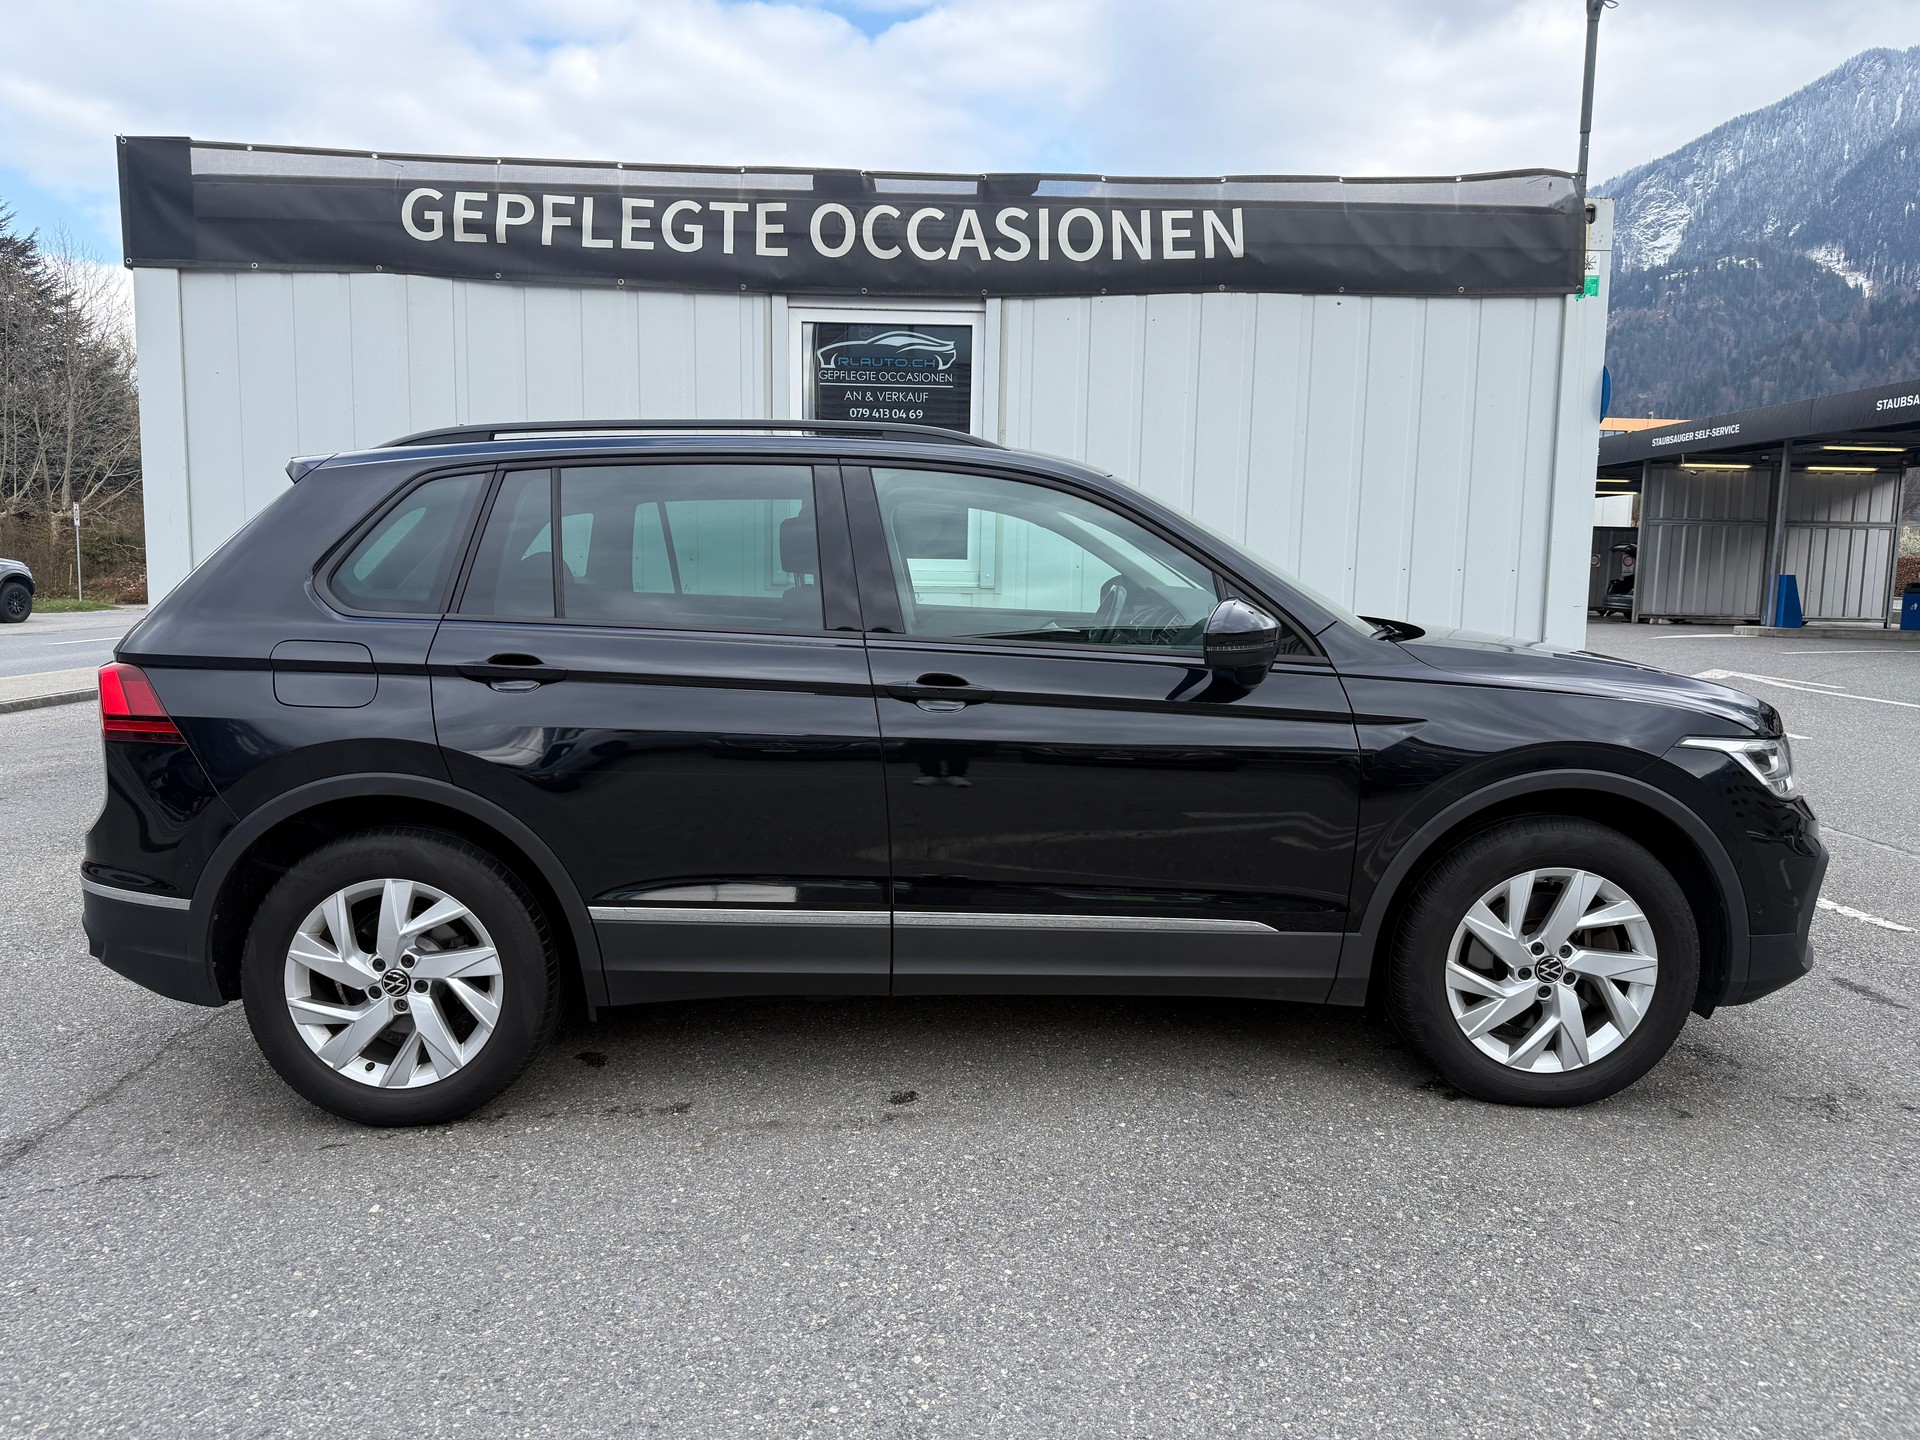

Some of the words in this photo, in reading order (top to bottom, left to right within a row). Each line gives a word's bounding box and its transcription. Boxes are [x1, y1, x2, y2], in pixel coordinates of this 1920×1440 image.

[401, 187, 789, 257] GEPFLEGTE
[809, 202, 1245, 262] OCCASIONEN
[837, 357, 936, 368] RLAUTO.CH
[819, 370, 876, 381] GEPFLEGTE
[878, 371, 953, 383] OCCASIONEN
[844, 390, 861, 401] AN
[865, 391, 874, 401] &
[876, 391, 929, 403] VERKAUF
[1876, 394, 1920, 411] STAUBSA
[849, 408, 869, 418] 079
[872, 408, 889, 419] 413
[892, 408, 907, 419] 04
[909, 409, 923, 419] 69
[1651, 431, 1694, 447] STAUBSAUGER
[1694, 424, 1740, 440] SELF-SERVICE
